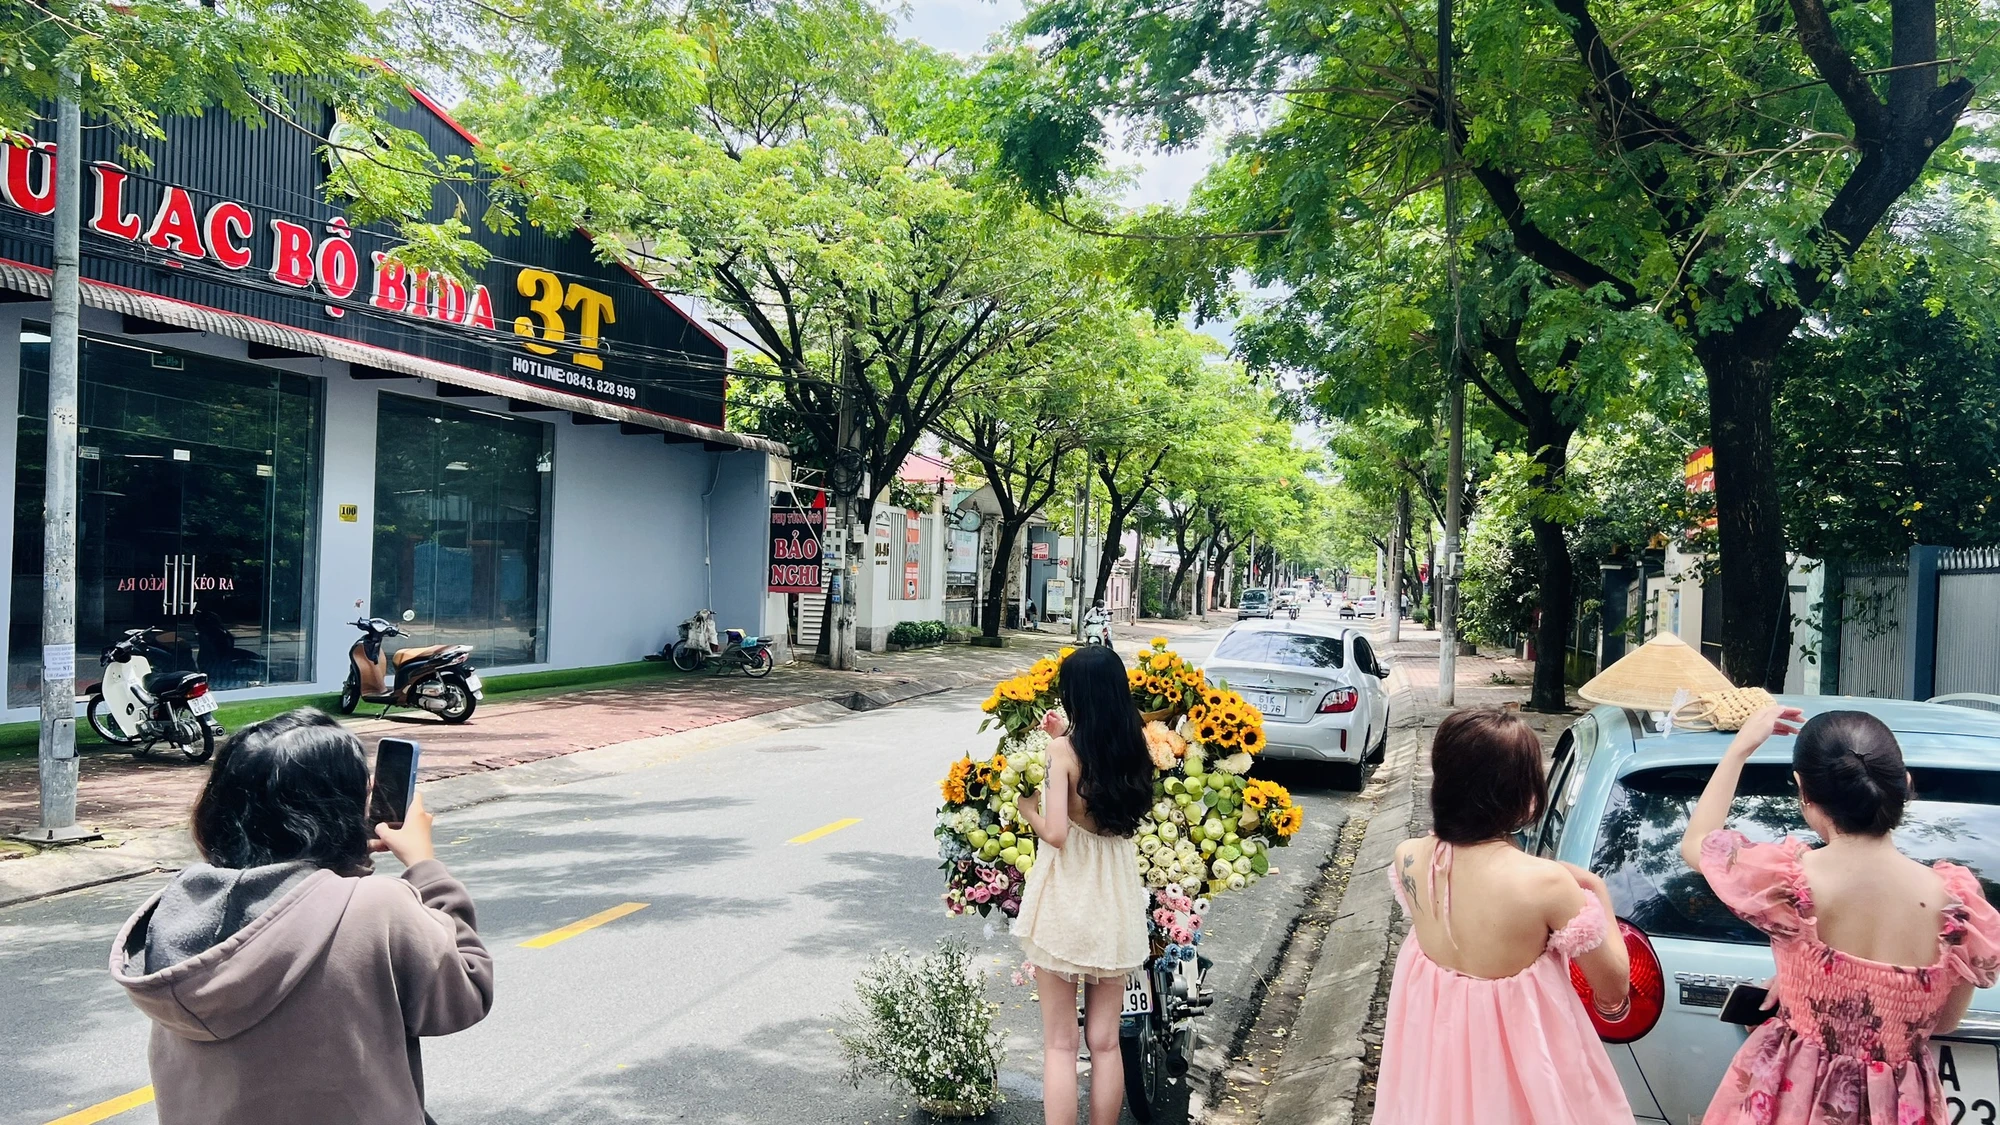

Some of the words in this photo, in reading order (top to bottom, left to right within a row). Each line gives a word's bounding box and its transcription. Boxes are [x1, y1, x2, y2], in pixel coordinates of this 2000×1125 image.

[89, 161, 253, 270] LẠC
[269, 216, 359, 317] BỘ
[370, 251, 497, 340] BIDA
[514, 268, 616, 371] 3T
[341, 506, 357, 516] 100
[774, 530, 818, 559] BẢO
[219, 577, 234, 590] RA
[771, 565, 819, 586] NGHI
